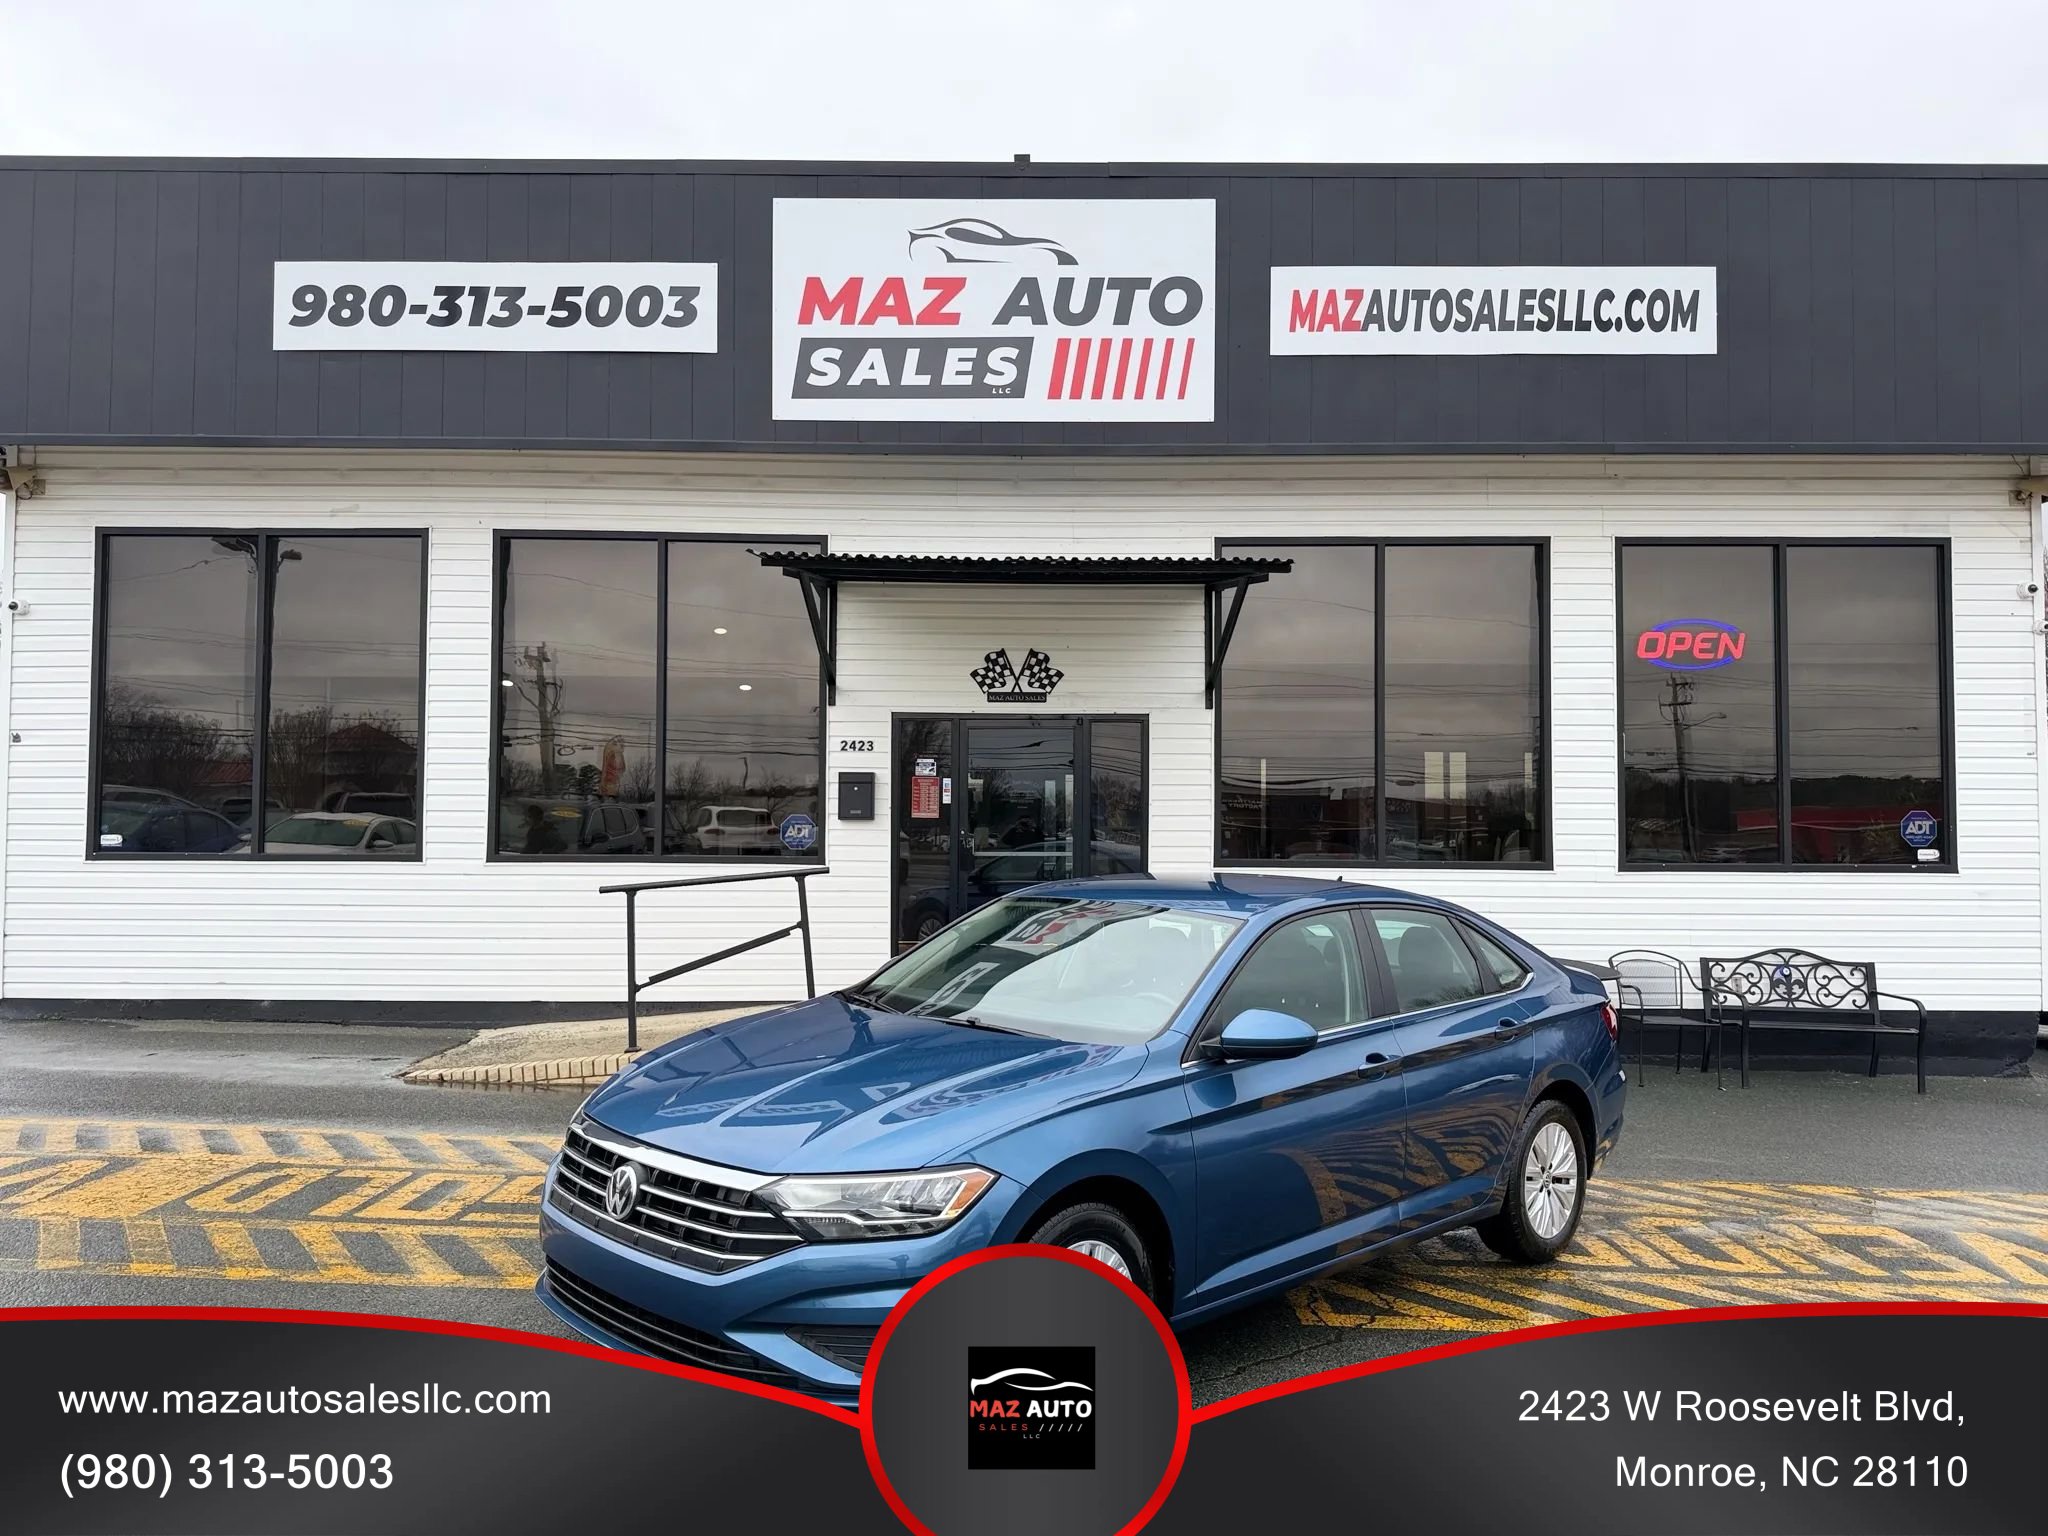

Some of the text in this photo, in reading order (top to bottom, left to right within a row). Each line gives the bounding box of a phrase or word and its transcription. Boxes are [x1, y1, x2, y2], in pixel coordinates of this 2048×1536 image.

[288, 283, 701, 330] 980-313-5003
[797, 275, 1204, 328] MAZ AUTO
[1288, 288, 1701, 333] MAZAUTOSALESLLC.COM
[806, 346, 1020, 387] SALES
[1637, 631, 1746, 660] OPEN
[840, 740, 874, 752] 2423
[784, 824, 813, 838] ADT
[1905, 820, 1934, 835] ADT
